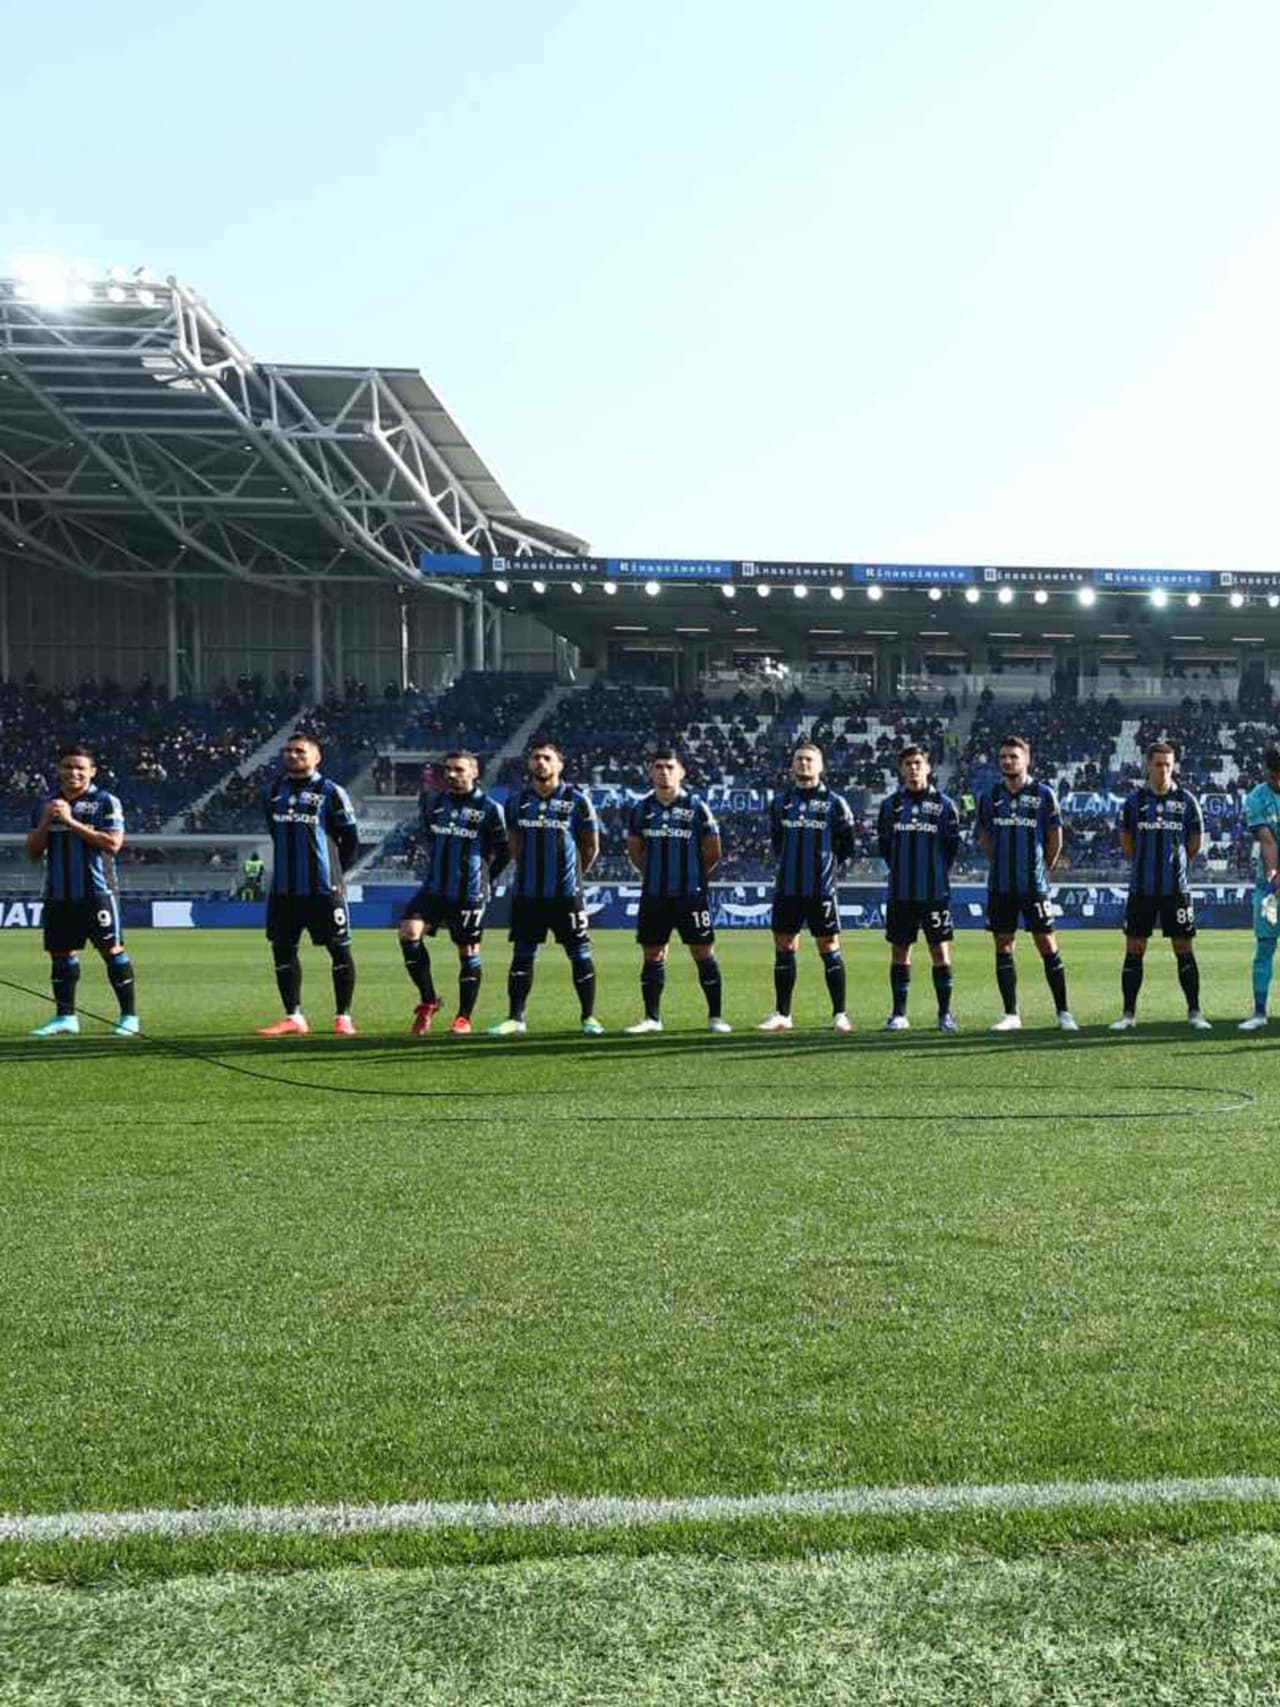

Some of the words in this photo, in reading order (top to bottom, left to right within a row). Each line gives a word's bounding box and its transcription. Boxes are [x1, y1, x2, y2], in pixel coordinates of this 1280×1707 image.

[97, 910, 112, 927] 9
[333, 907, 346, 926] 6
[461, 909, 482, 928] 77
[822, 901, 833, 918] 7
[568, 911, 588, 929] 15
[692, 910, 710, 928] 18
[931, 910, 953, 928] 32
